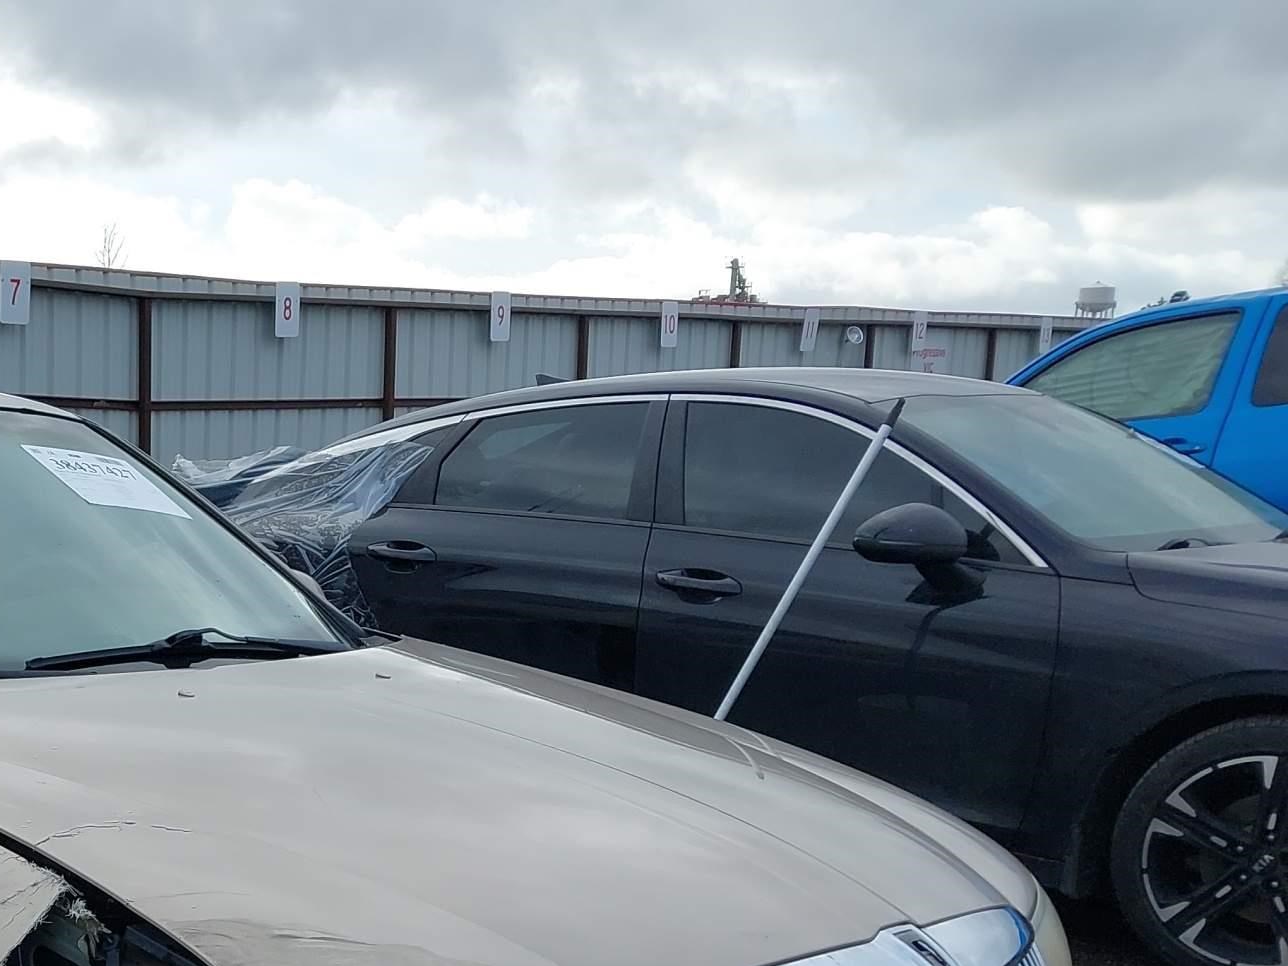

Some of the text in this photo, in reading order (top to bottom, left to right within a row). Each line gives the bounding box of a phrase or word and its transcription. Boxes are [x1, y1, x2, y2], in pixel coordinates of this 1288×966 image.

[9, 278, 21, 305] 7
[283, 296, 292, 321] 8
[497, 305, 505, 326] 9
[664, 314, 676, 335] 10
[805, 321, 815, 338] 11
[915, 322, 925, 340] 12
[49, 458, 138, 480] 38437427
[1252, 854, 1275, 872] KIA
